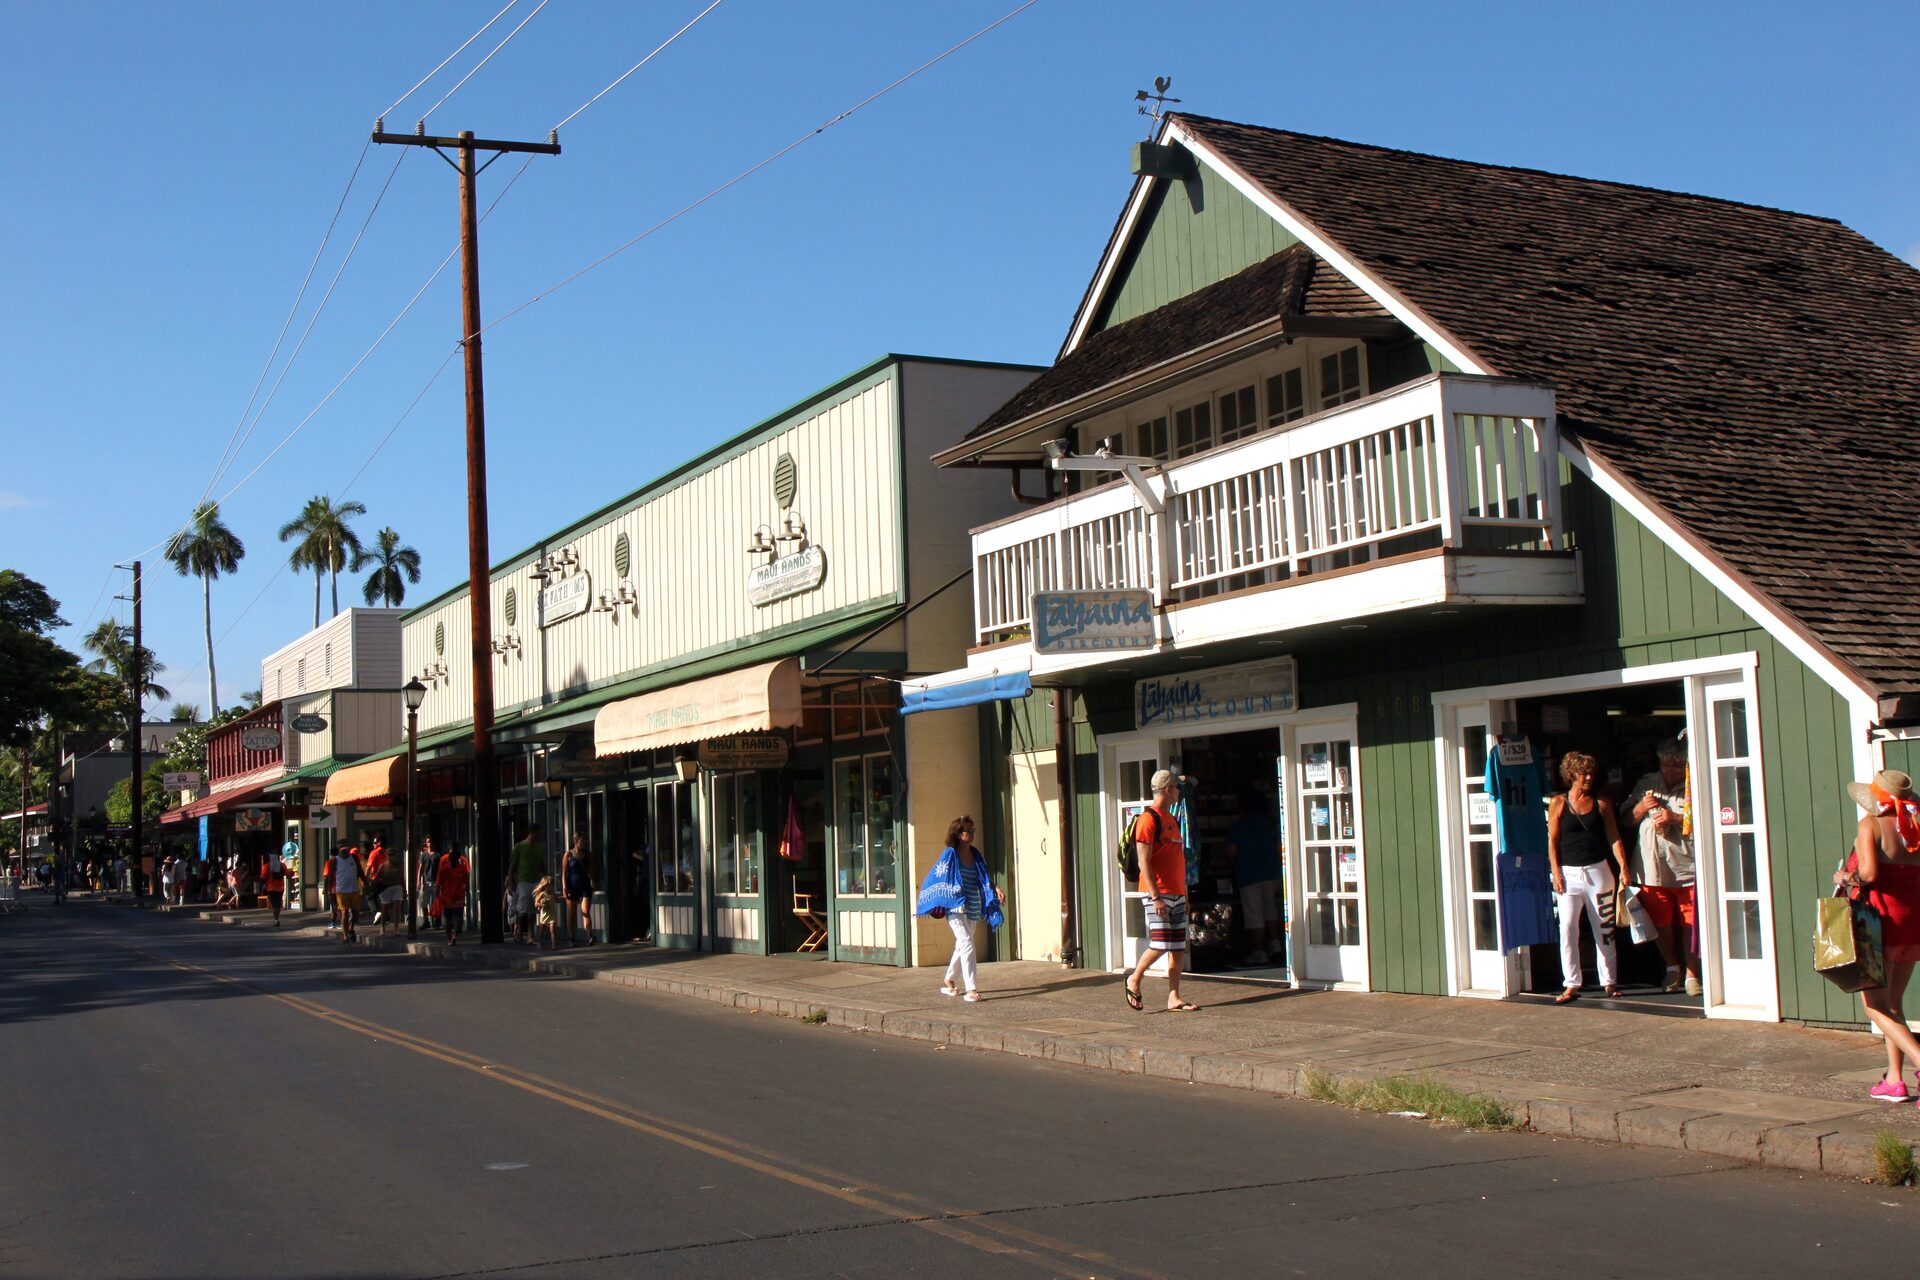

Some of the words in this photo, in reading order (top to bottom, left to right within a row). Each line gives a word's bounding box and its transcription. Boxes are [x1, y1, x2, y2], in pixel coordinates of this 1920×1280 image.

[757, 564, 778, 582] MAUI
[781, 552, 812, 574] HANDS
[1057, 635, 1153, 649] DISCOUNT
[1166, 690, 1292, 724] DISCOUNT
[1377, 694, 1420, 717] 608
[244, 735, 279, 746] TATTOO
[709, 738, 737, 750] MAUI
[741, 738, 779, 749] HANDS
[1502, 744, 1526, 755] 7/$20
[1596, 889, 1617, 946] LOVE
